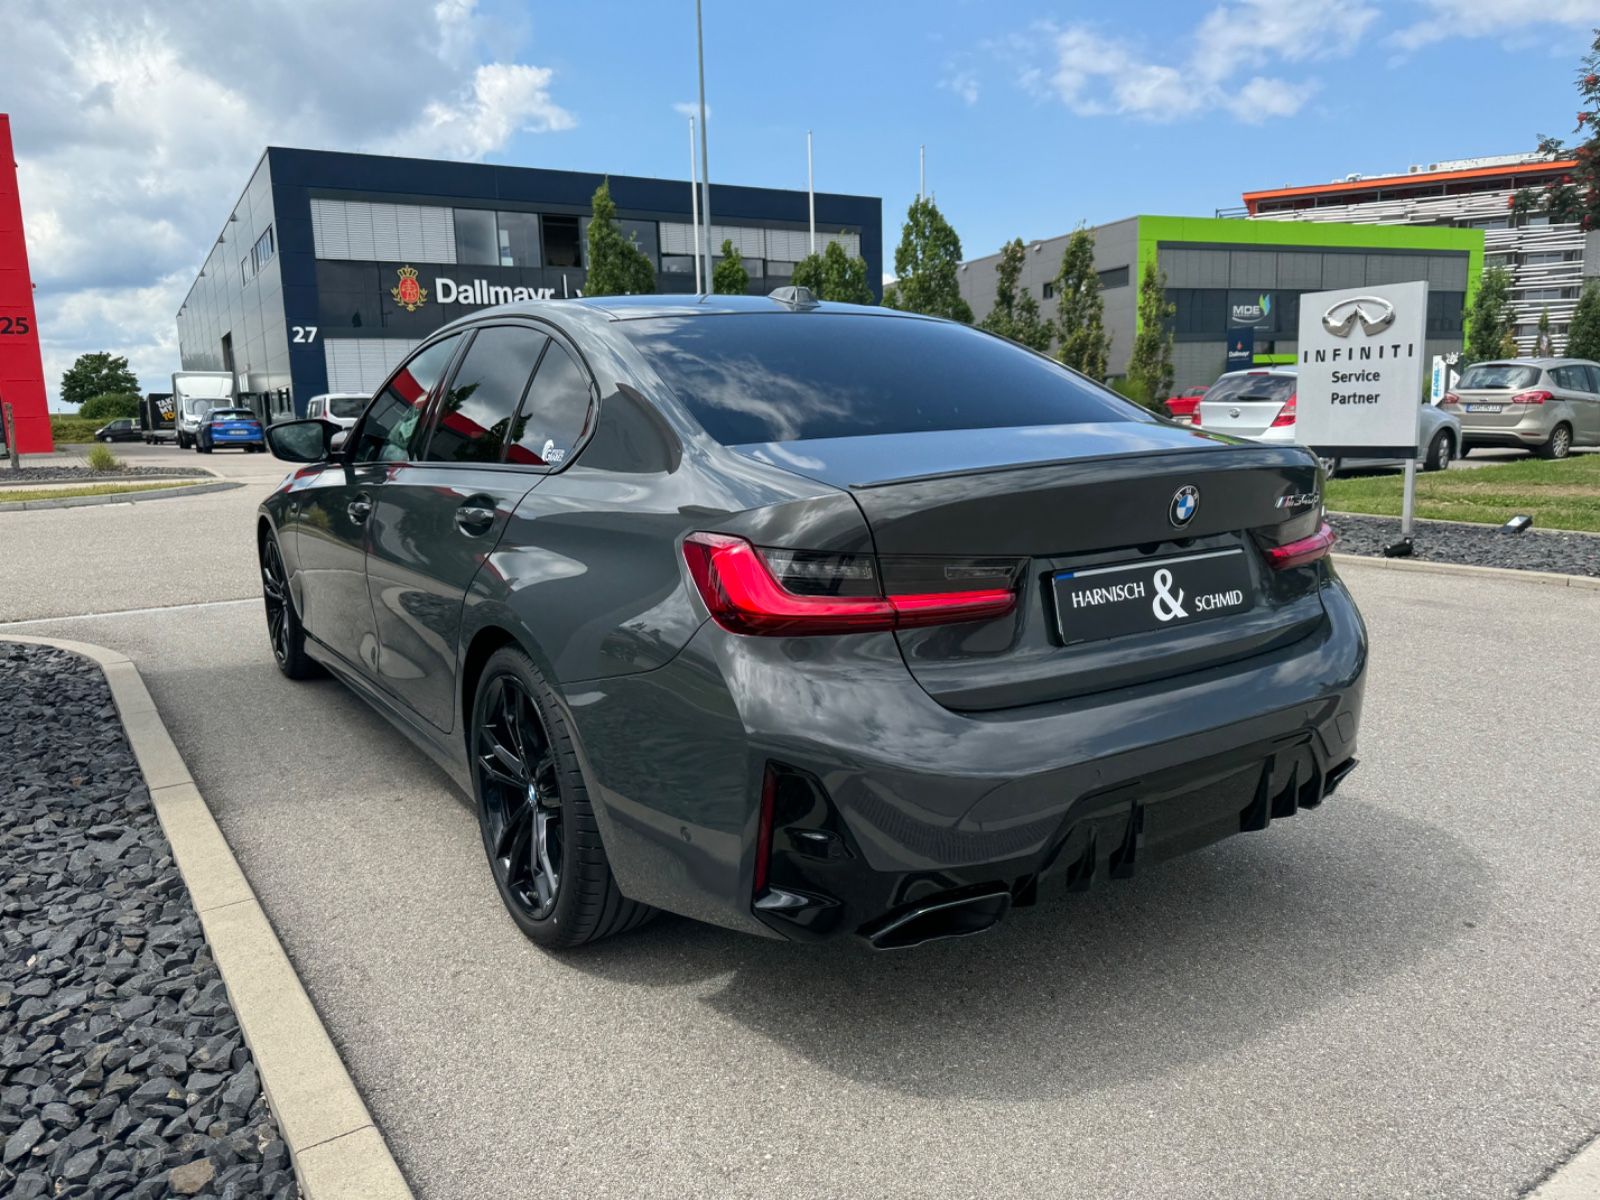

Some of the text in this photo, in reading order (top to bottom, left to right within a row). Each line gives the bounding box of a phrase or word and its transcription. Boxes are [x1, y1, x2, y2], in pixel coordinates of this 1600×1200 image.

[435, 278, 555, 305] Dallmayr
[1232, 305, 1260, 315] MDE
[0, 317, 29, 335] 25
[292, 326, 318, 343] 27
[1303, 343, 1414, 363] INFINITI
[1331, 369, 1381, 383] Service
[155, 397, 174, 408] TAK
[1330, 392, 1381, 405] Partner
[159, 404, 173, 414] MY
[162, 411, 176, 421] TO
[1071, 568, 1243, 622] HARNISCH & SCHMID
